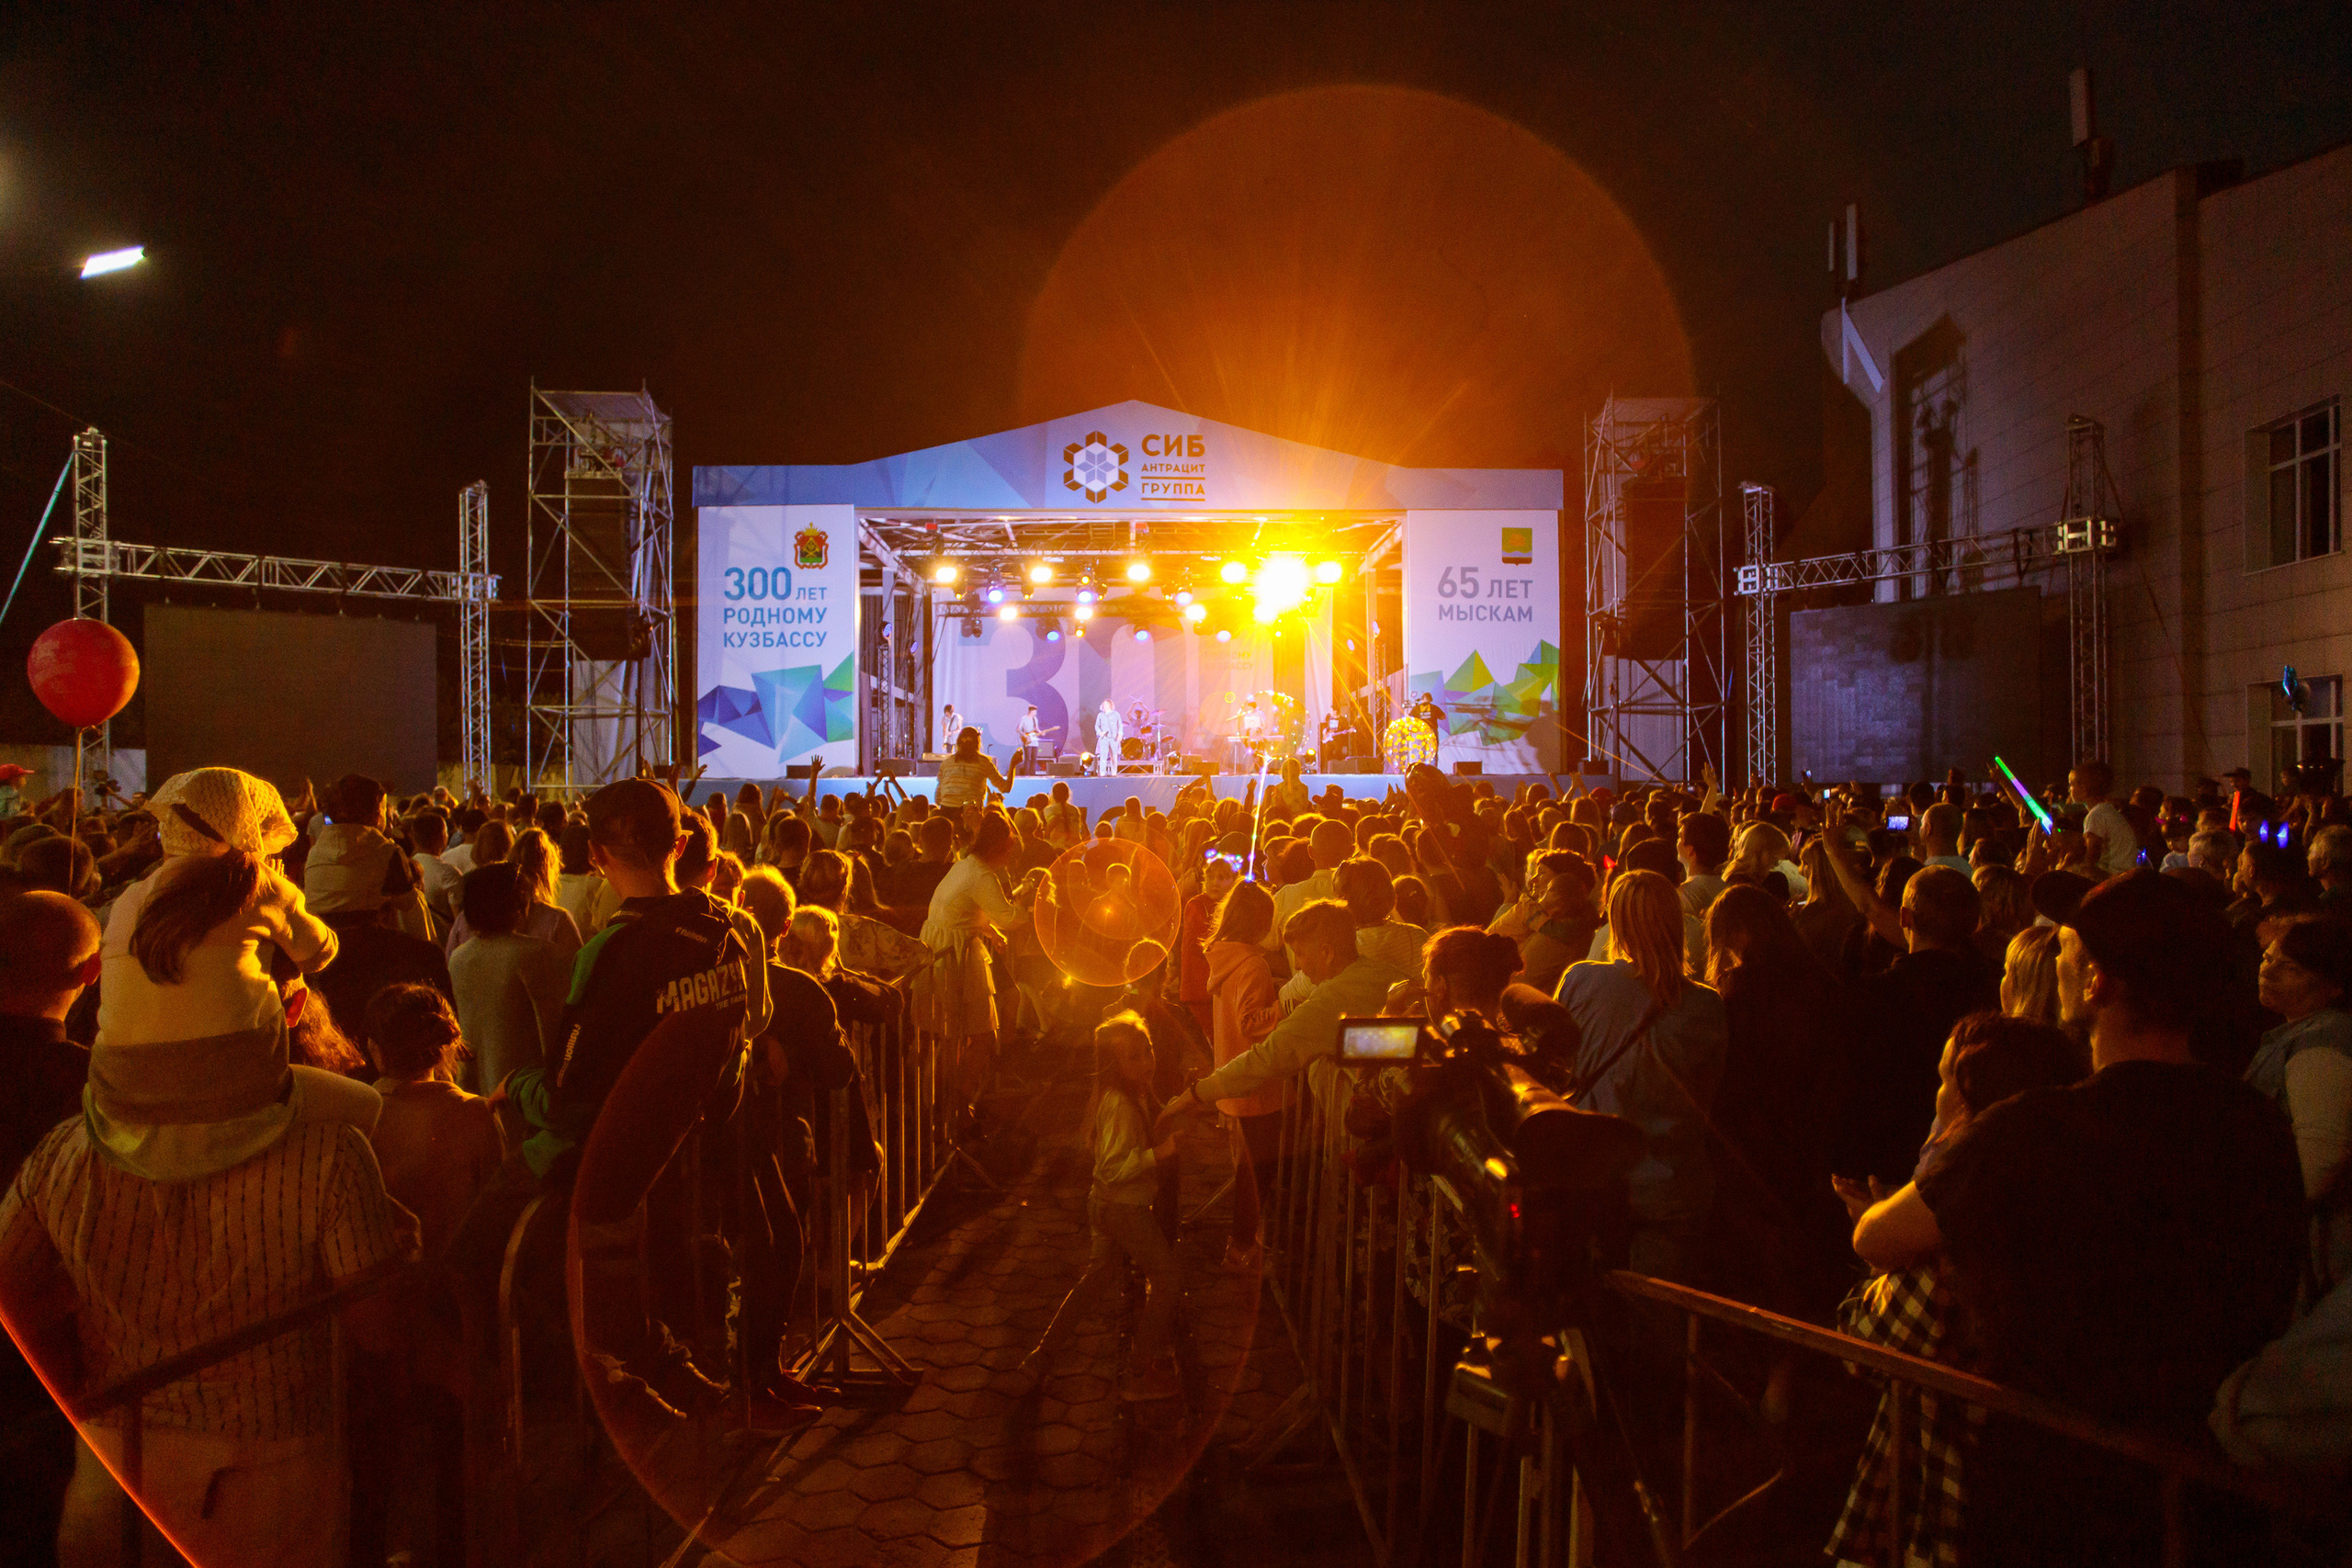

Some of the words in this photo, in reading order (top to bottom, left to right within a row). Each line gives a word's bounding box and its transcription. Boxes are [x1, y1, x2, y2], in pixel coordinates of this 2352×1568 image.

[1141, 434, 1205, 457] СИБ
[1141, 463, 1205, 474] АНТРАЦИТ
[1141, 482, 1205, 495] ГРУППА
[723, 567, 792, 601] 300
[795, 587, 828, 601] ЛЕТ
[1437, 566, 1479, 598] 65
[1487, 580, 1533, 599] ЛЕТ
[723, 607, 828, 627] РОДНОМУ
[1438, 605, 1533, 622] МЫСКАМ
[723, 630, 828, 648] КУЗБАССУ
